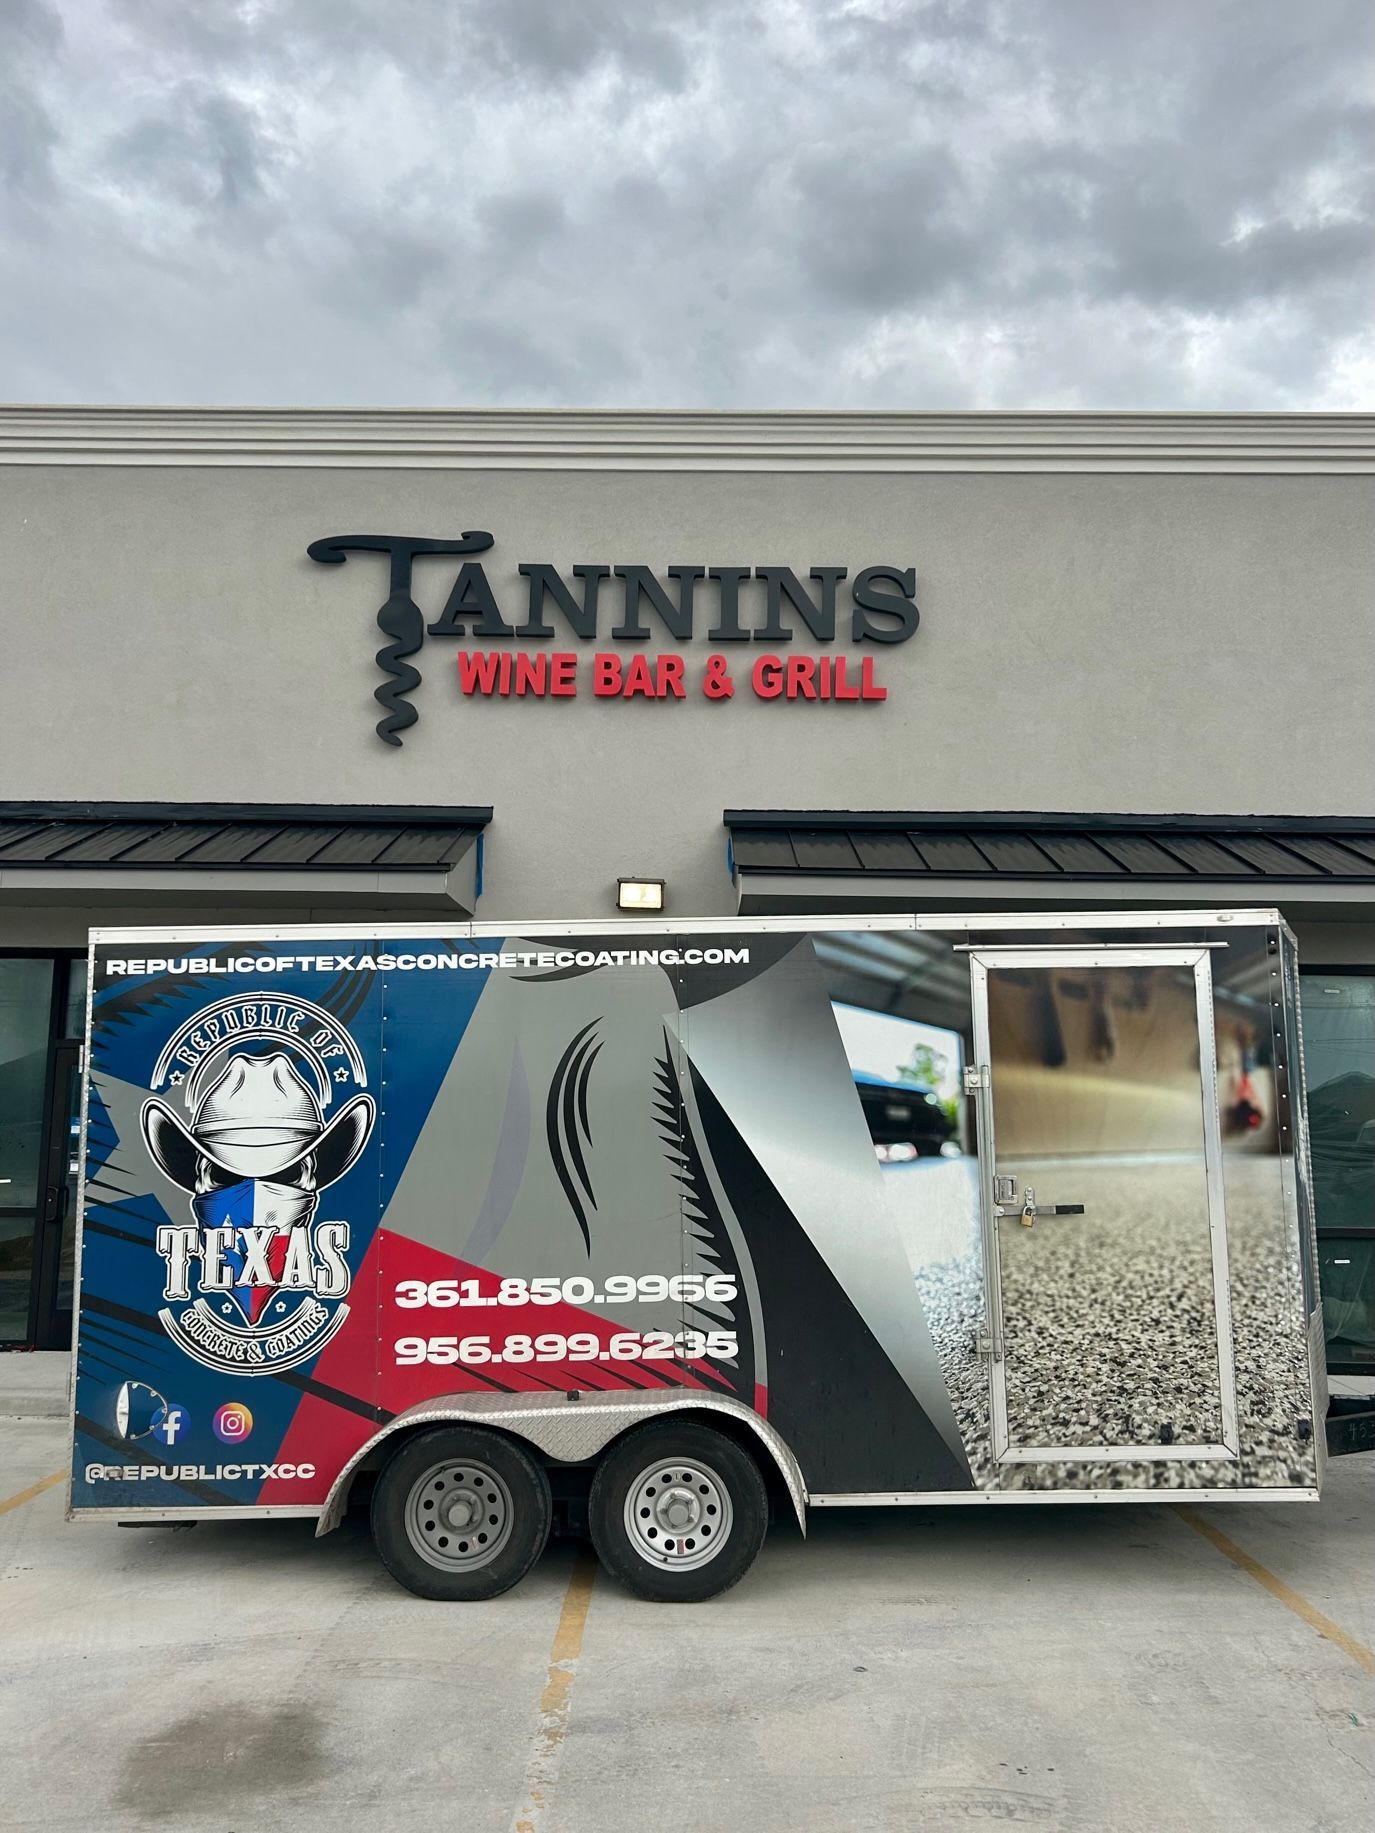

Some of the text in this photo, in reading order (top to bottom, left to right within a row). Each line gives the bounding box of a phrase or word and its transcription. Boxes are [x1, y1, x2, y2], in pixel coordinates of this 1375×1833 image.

[307, 531, 921, 747] TANNINS
[458, 651, 888, 701] WINE BAR & GRILL
[106, 948, 750, 975] REPUBLICOFTEXASCONCRETECOATING.COM
[177, 1004, 344, 1066] REPUBLIC OF
[157, 1222, 351, 1300] TEXAS
[395, 1275, 738, 1308] 361.850.9966
[180, 1303, 329, 1363] CONCRETE & COATINGS
[394, 1331, 739, 1365] 956.899.6235
